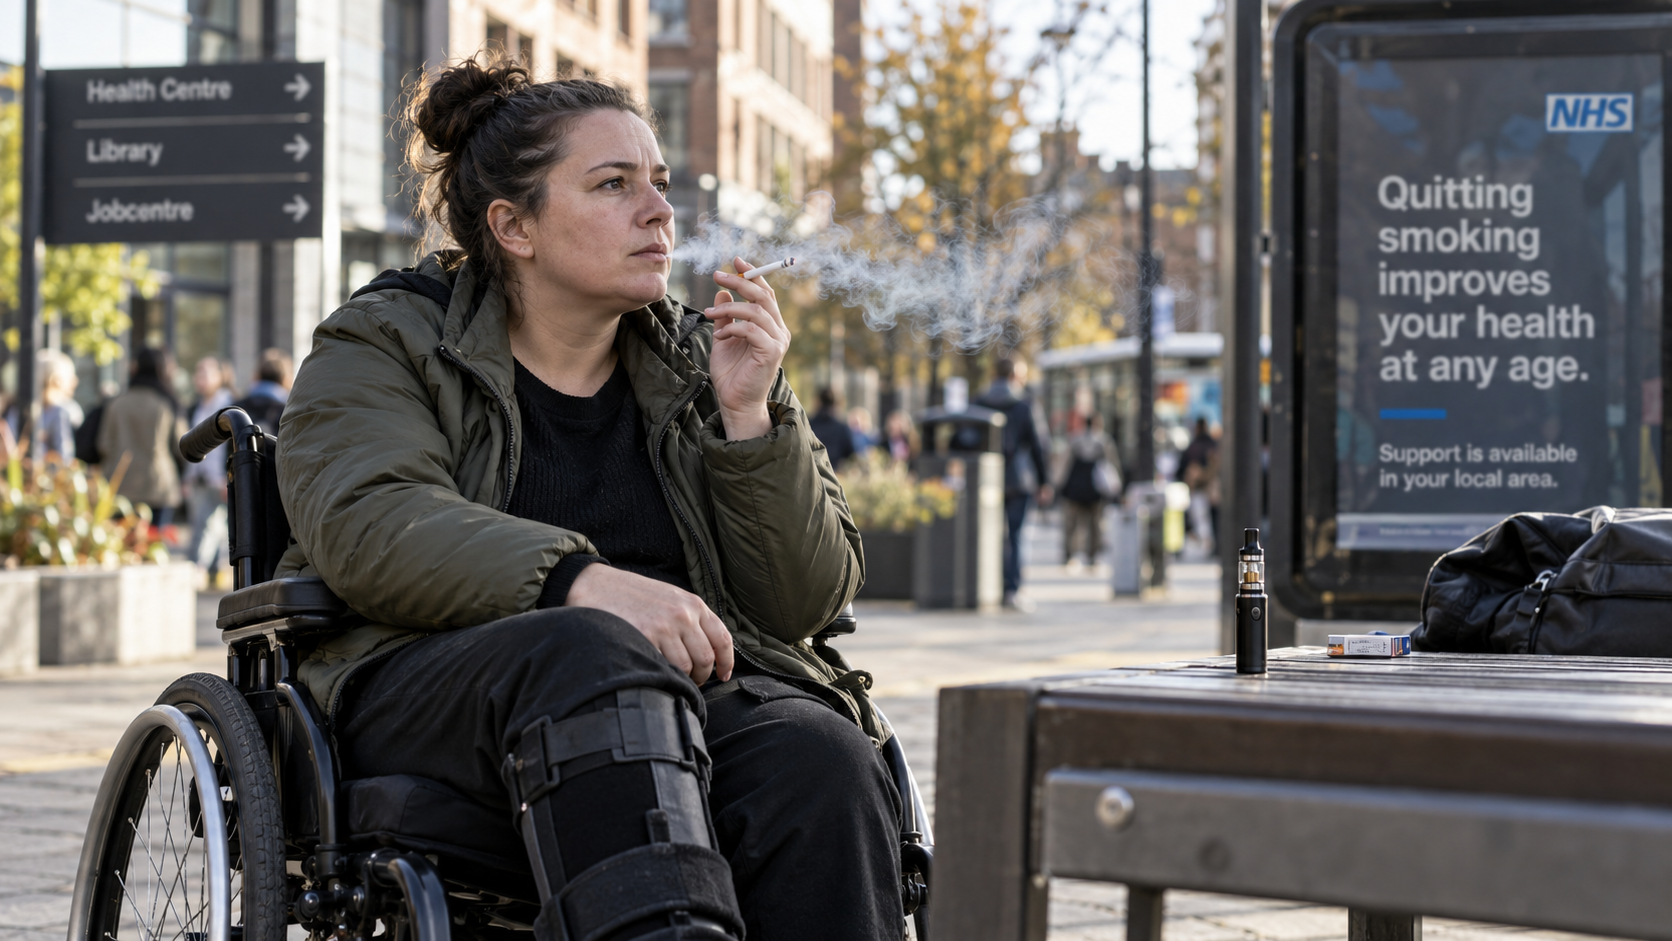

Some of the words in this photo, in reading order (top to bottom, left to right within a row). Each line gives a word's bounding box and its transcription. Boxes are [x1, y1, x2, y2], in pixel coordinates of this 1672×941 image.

[86, 78, 156, 103] Health
[159, 77, 232, 100] Centre
[1550, 98, 1628, 128] NHS
[86, 138, 163, 166] Library
[86, 198, 194, 223] Jobcentre
[1378, 175, 1533, 217] Quitting
[1378, 219, 1540, 260] smoking
[1378, 262, 1551, 303] improves
[1378, 313, 1466, 347] your
[1476, 305, 1595, 339] health
[1379, 350, 1418, 382] at
[1428, 355, 1498, 389] any
[1508, 355, 1589, 389] age.
[1379, 443, 1462, 468] Support
[1466, 443, 1484, 463] is
[1488, 443, 1578, 463] available
[1379, 469, 1398, 488] in
[1402, 472, 1450, 492] your
[1454, 469, 1503, 489] local
[1507, 472, 1558, 489] area.
